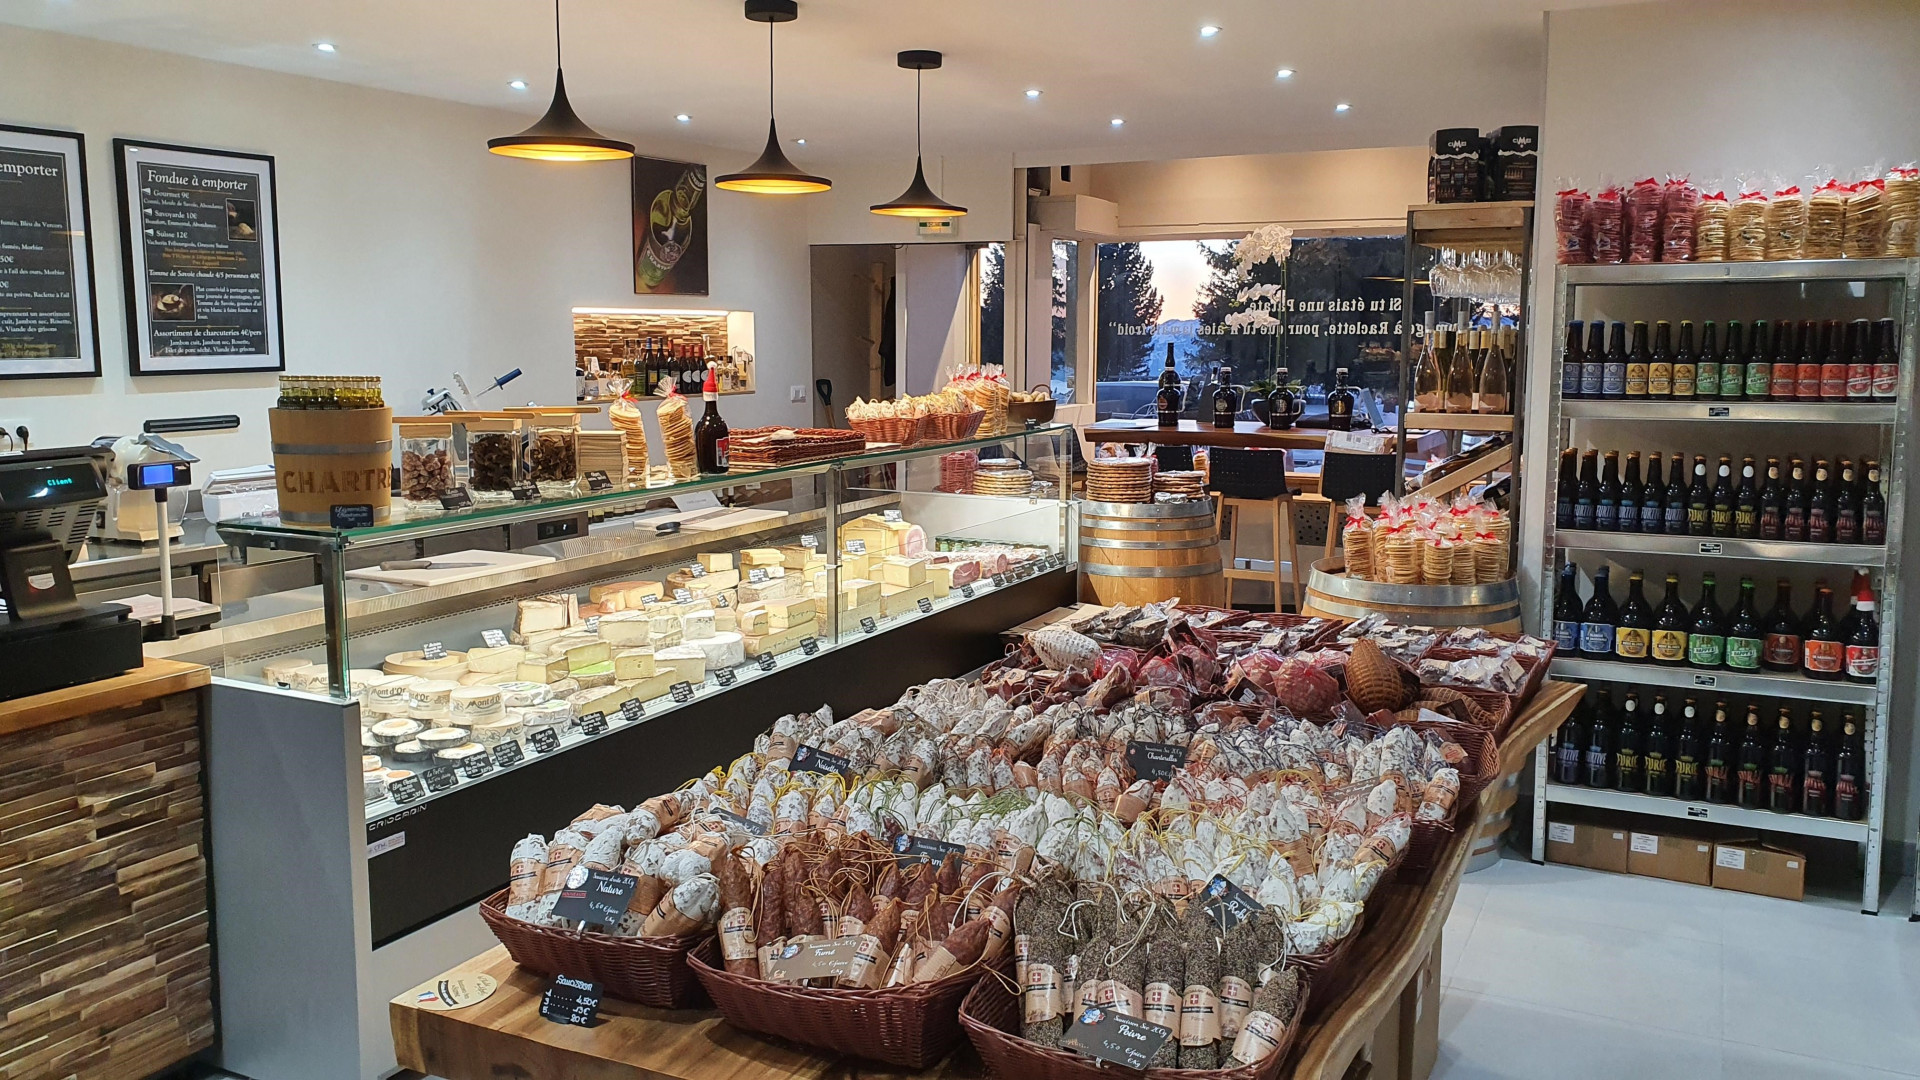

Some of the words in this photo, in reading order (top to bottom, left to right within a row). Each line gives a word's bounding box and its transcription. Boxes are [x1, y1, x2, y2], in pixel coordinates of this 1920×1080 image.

[147, 170, 189, 185] Fondue
[192, 175, 199, 186] à
[202, 178, 248, 191] emporter
[153, 190, 181, 198] Gourmet
[154, 210, 185, 219] Savoyarde
[156, 230, 175, 238] Suisse
[176, 231, 188, 239] 12€
[149, 269, 169, 277] Tomme
[177, 270, 195, 278] Savoie
[47, 478, 73, 486] Client
[1147, 752, 1178, 762] Chanterelles
[369, 804, 428, 831] CRIOCABIN
[596, 881, 624, 896] Nature
[815, 948, 836, 957] Fumé
[1117, 1024, 1147, 1041] Poivre
